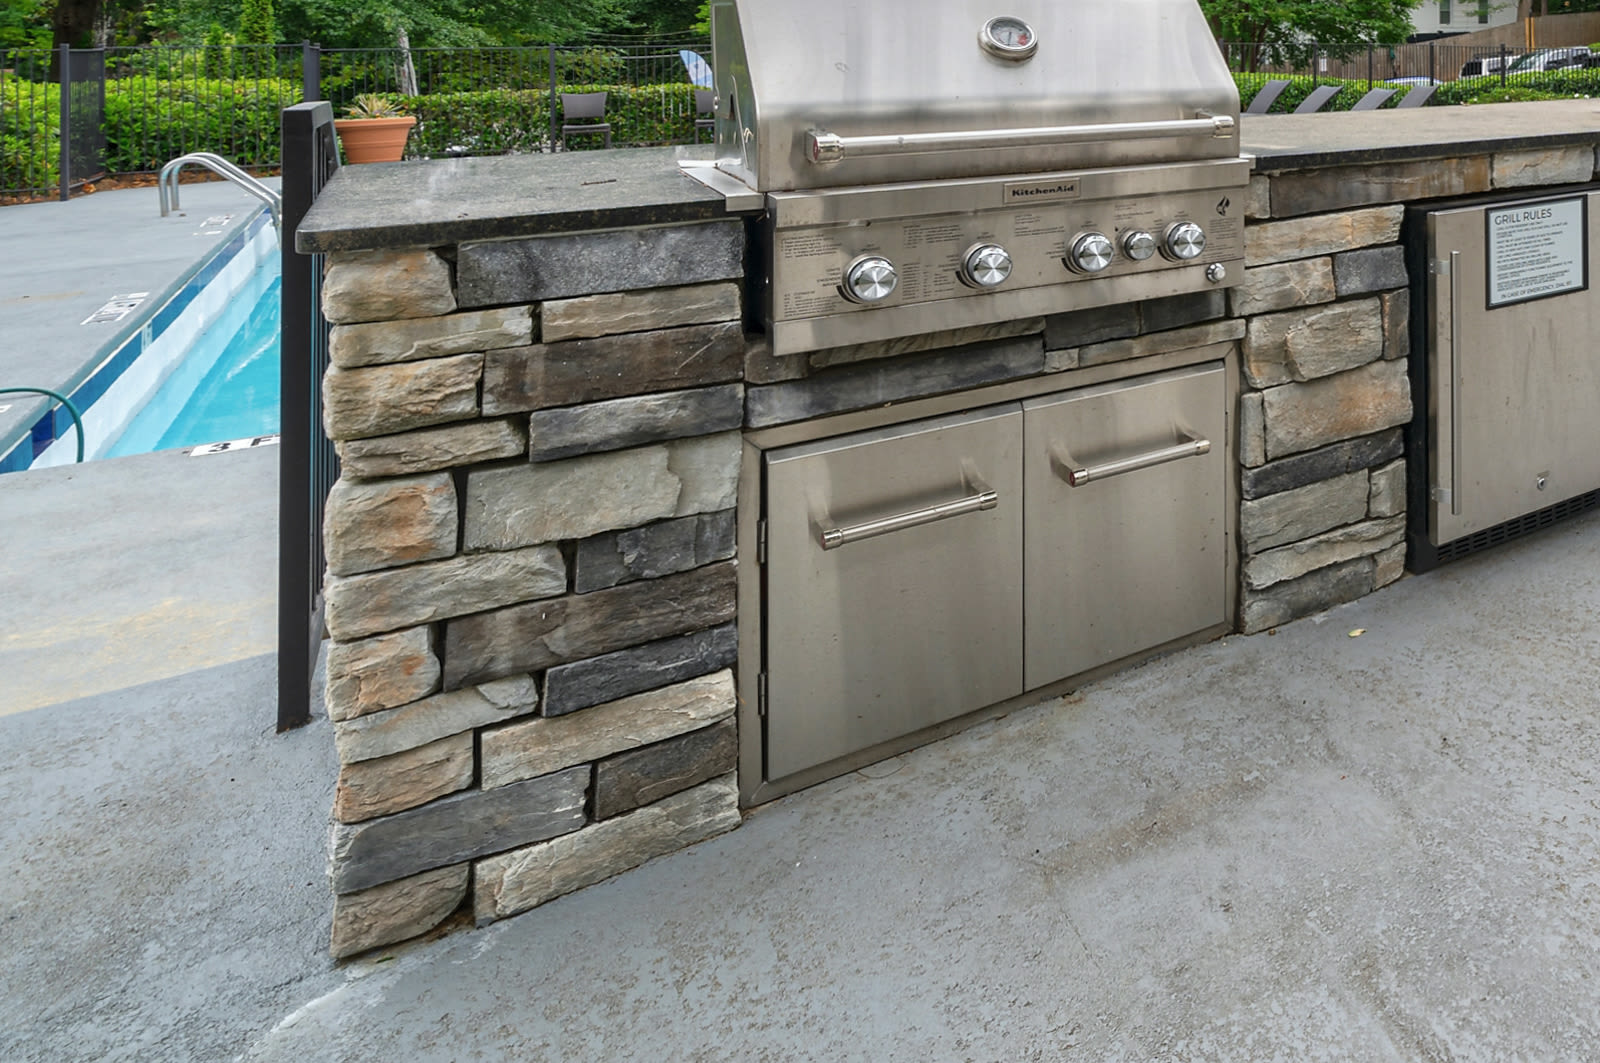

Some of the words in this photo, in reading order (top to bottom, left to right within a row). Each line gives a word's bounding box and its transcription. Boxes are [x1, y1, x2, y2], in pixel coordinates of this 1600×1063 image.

[1012, 185, 1074, 196] KitchenAid
[1494, 214, 1521, 225] GRILL
[1523, 208, 1552, 221] RULES
